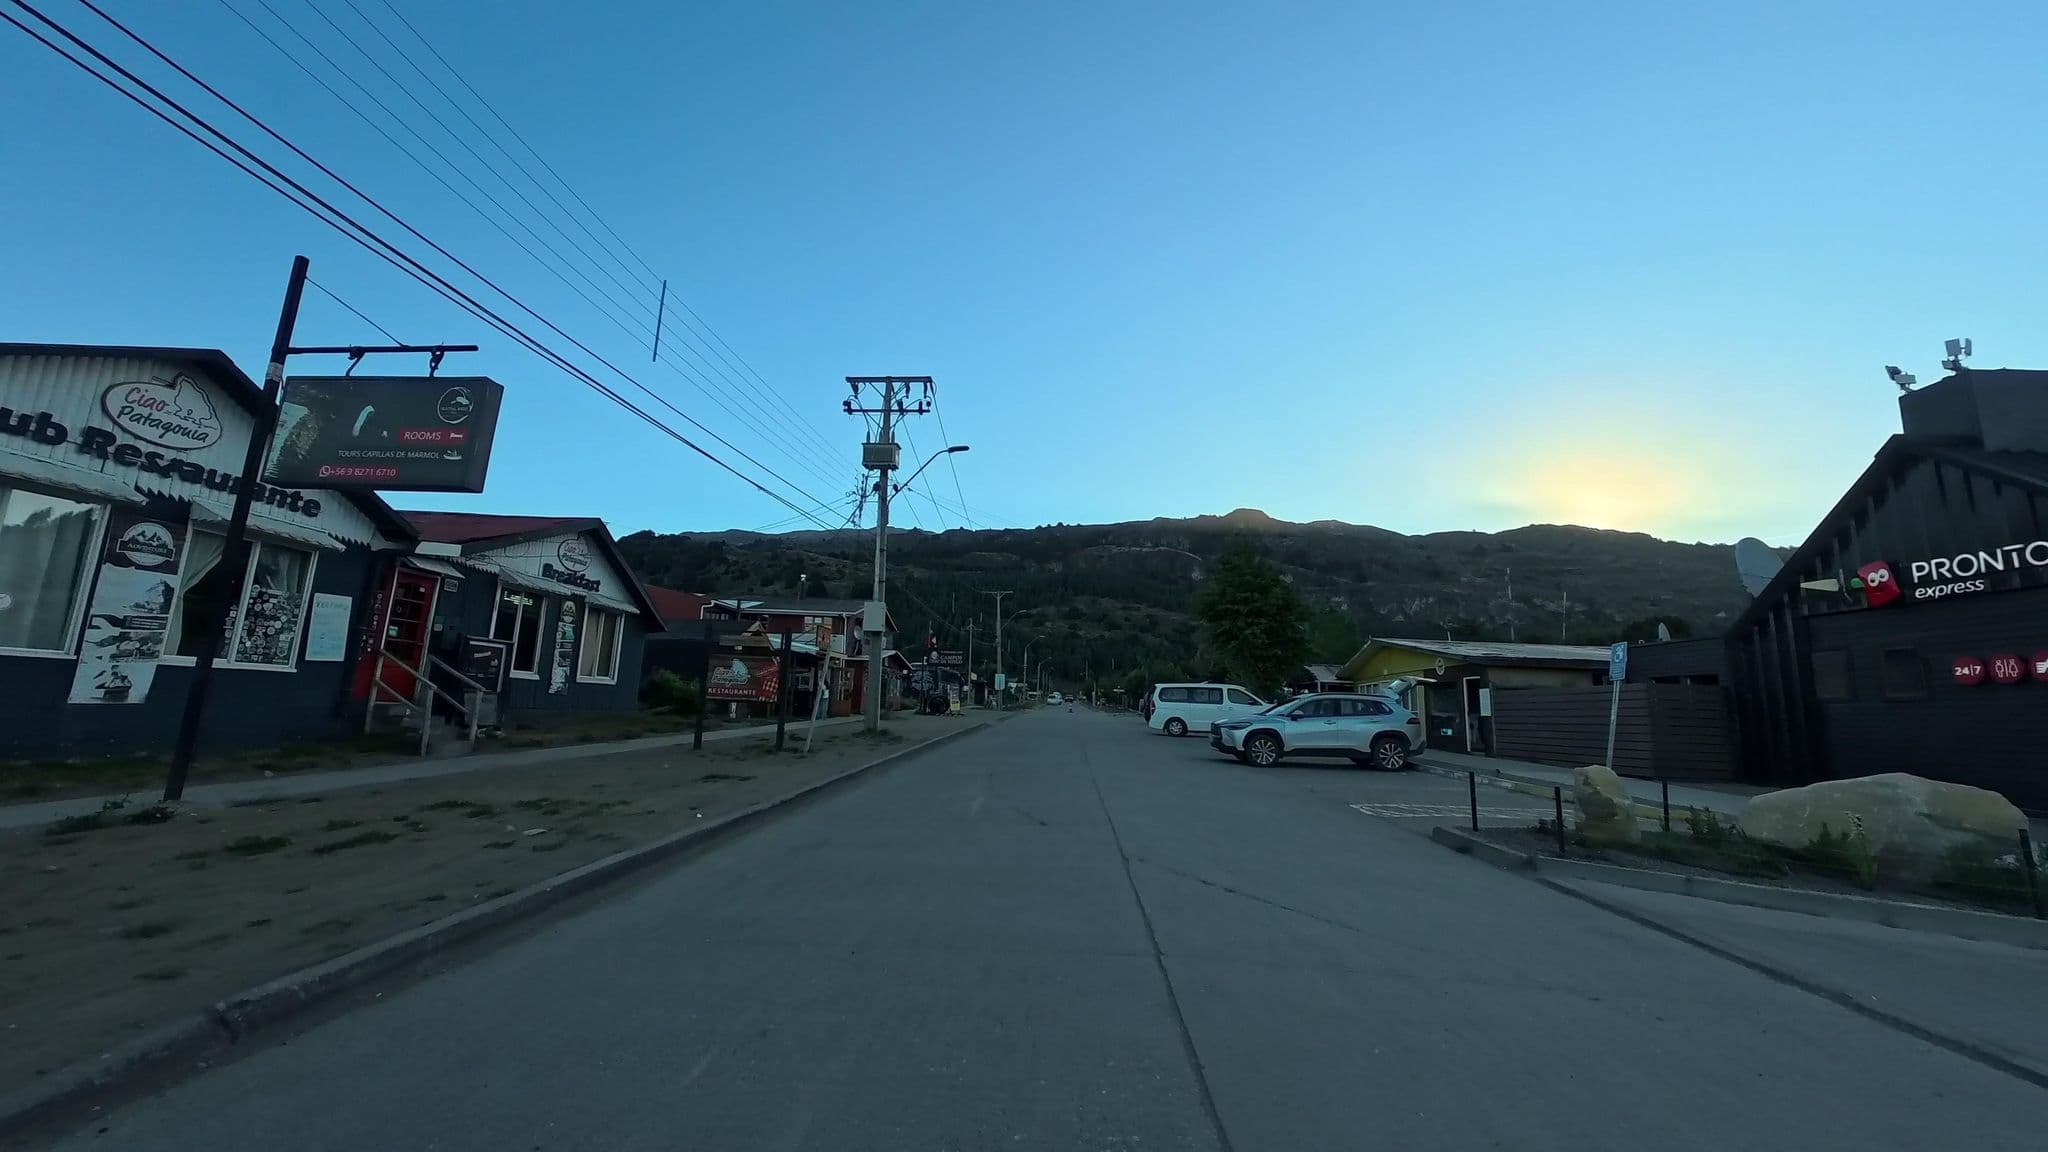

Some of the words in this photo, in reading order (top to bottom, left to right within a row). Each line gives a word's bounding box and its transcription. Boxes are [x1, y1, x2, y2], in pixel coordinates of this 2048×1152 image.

[125, 387, 168, 412] Ciao
[117, 406, 209, 443] Patagonia
[404, 431, 441, 441] ROOMS
[337, 450, 360, 458] TOURS
[361, 450, 394, 458] CAPILLAS
[395, 451, 406, 459] DE
[354, 467, 373, 476] 8271
[375, 467, 397, 477] 6710
[1911, 541, 2048, 584] PRONTO
[1915, 579, 1985, 599] express
[707, 687, 756, 696] RESTAURANTE
